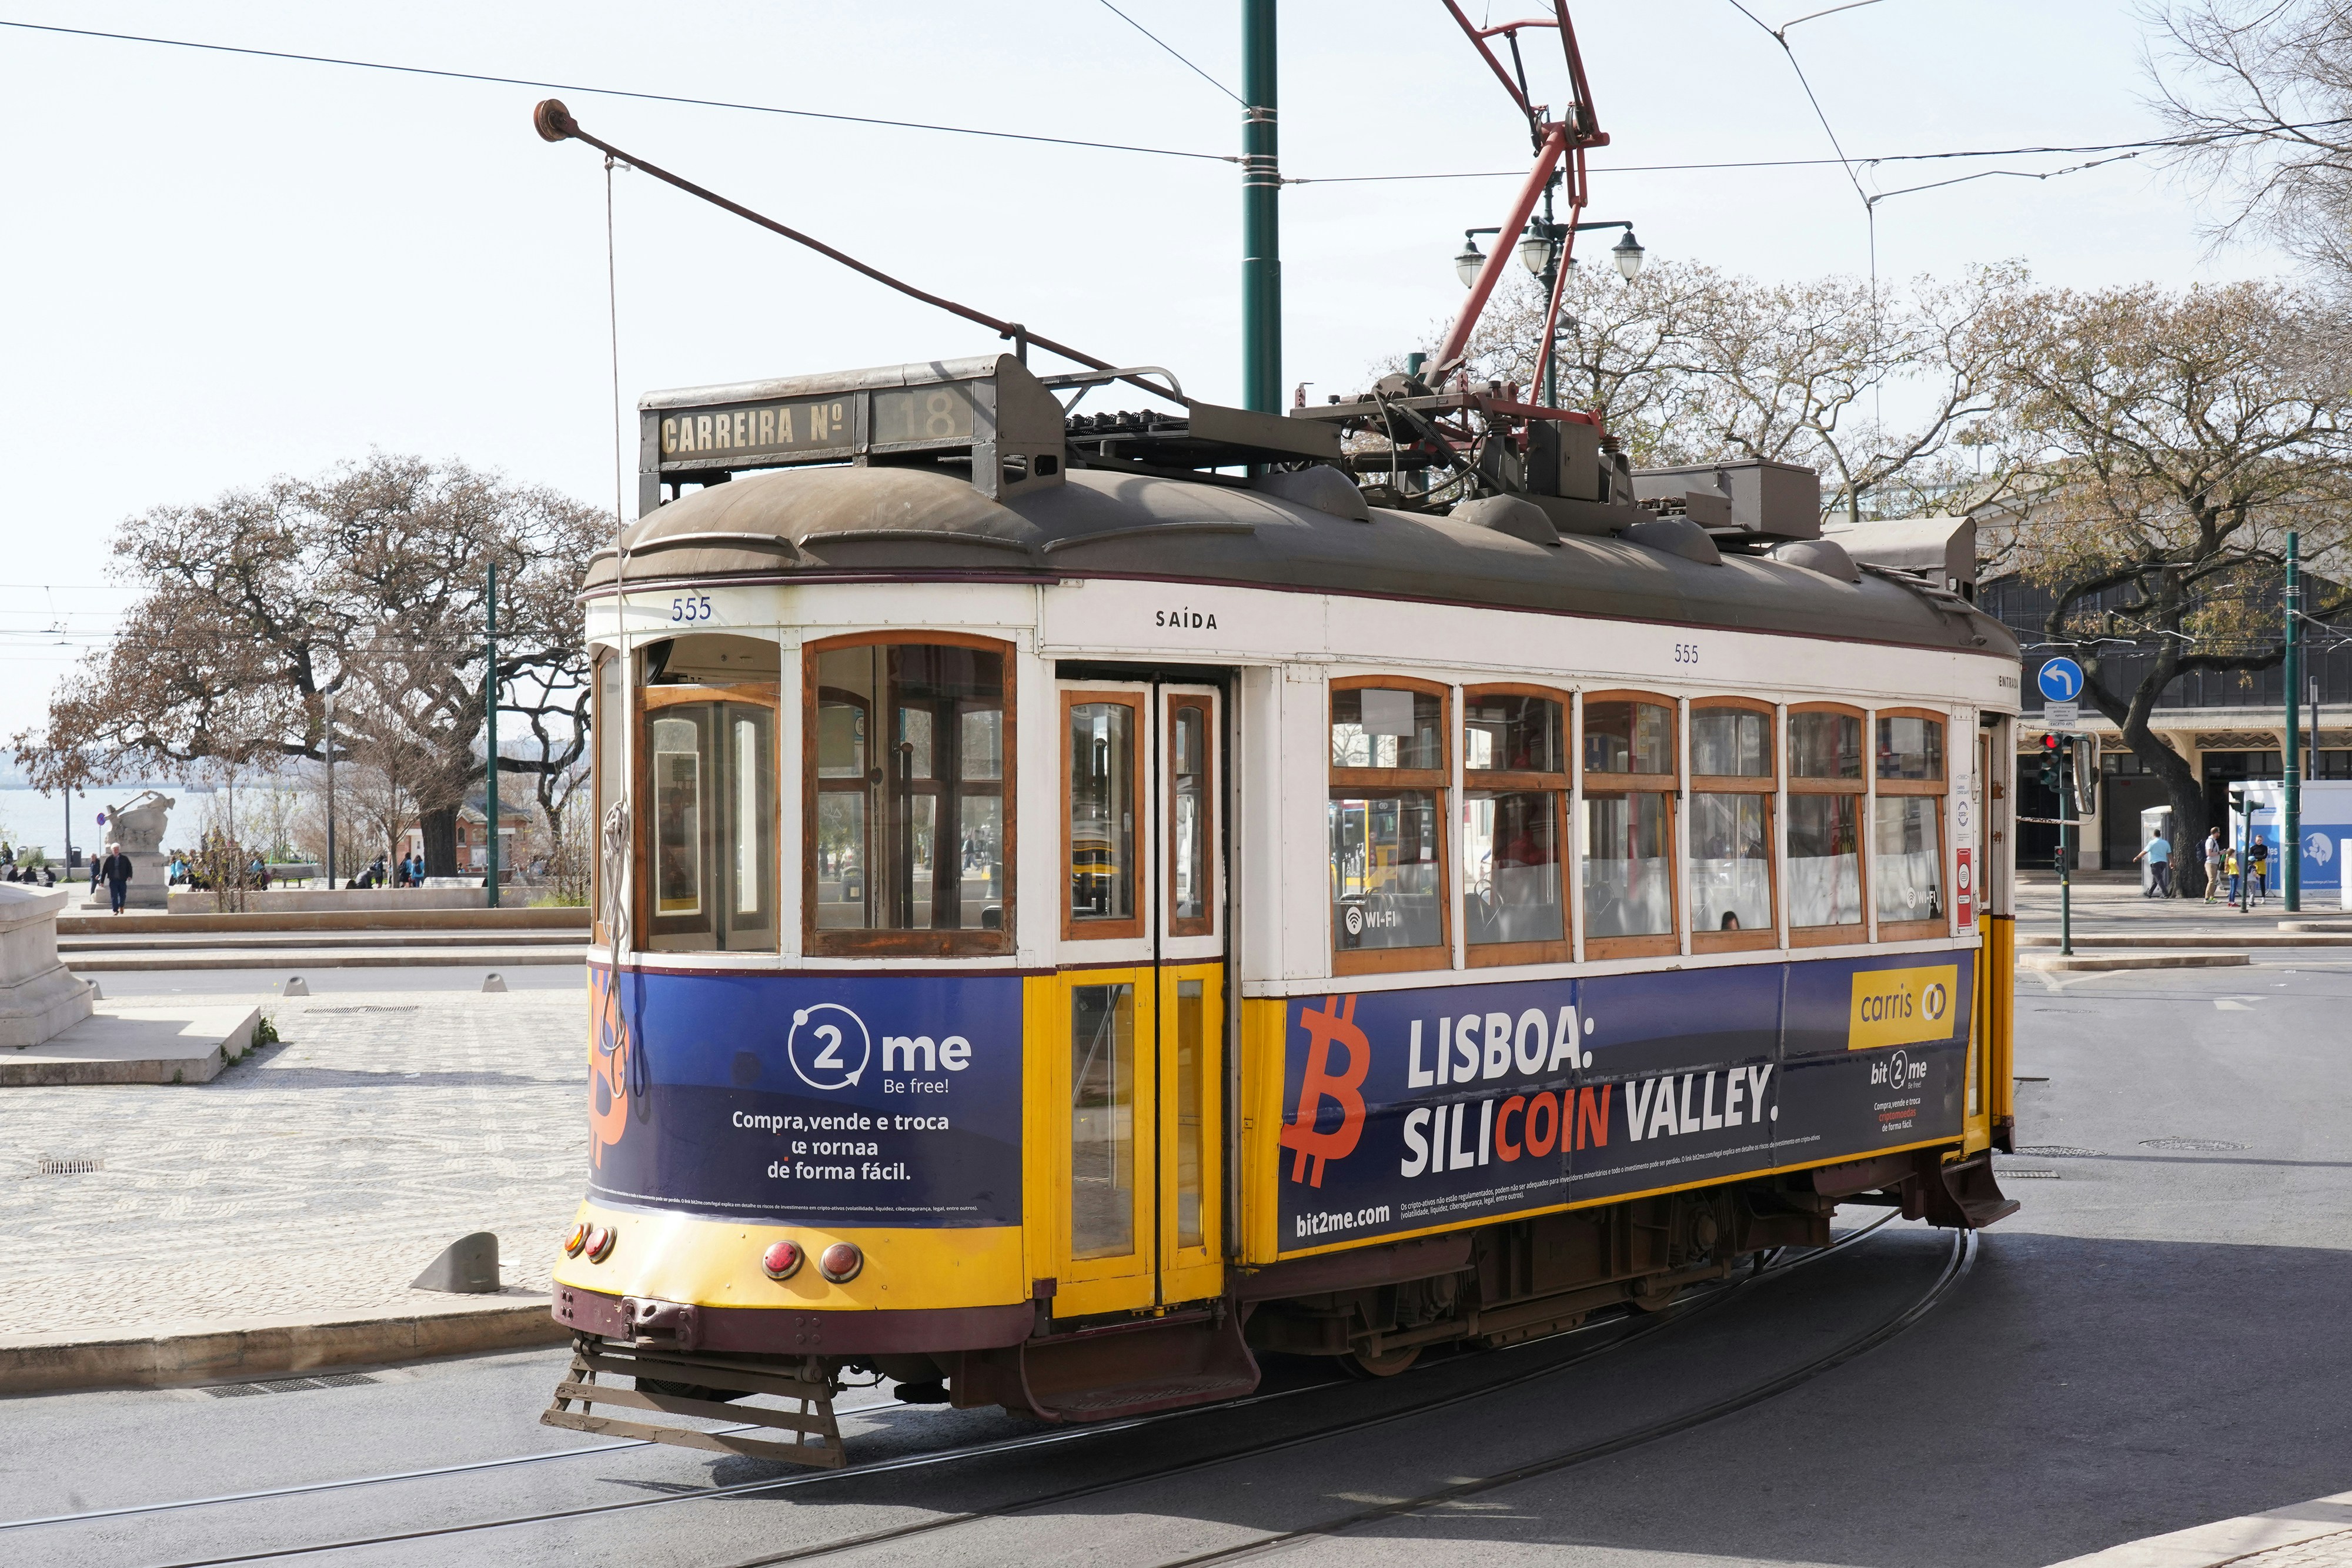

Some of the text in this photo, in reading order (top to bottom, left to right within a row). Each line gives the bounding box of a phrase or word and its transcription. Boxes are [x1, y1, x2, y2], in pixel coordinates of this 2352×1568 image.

[662, 408, 793, 454] CARREIRA
[901, 392, 955, 437] 18
[672, 596, 711, 621] 555
[1156, 607, 1217, 630] SAÍDA
[1675, 644, 1699, 664] 555
[1999, 676, 2019, 689] ENTRADA
[1917, 891, 1936, 904] WI-FI
[1365, 911, 1396, 928] WI-FI
[1862, 983, 1912, 1022] carris
[883, 1035, 972, 1072] me
[1408, 1006, 1594, 1089] LISBOA:
[1871, 1061, 1887, 1085] bit
[1908, 1061, 1927, 1079] me
[884, 1078, 949, 1094] Be free!
[877, 1115, 888, 1131] e
[894, 1112, 949, 1131] troca
[1401, 1064, 1779, 1178] SILICOIN VALLEY.
[1879, 1108, 1916, 1123] criptomoedas
[1882, 1119, 1912, 1132] de forma fácil.
[767, 1161, 911, 1181] de forma fácil.
[1408, 1199, 1436, 1211] cripto-ativos
[1445, 1195, 1458, 1203] estão
[1458, 1188, 1494, 1201] regulamentados,
[1495, 1185, 1509, 1196] podem
[1510, 1183, 1518, 1191] não
[1526, 1179, 1549, 1189] adequados
[1549, 1177, 1559, 1186] para
[1584, 1169, 1608, 1179] minoritários
[1624, 1163, 1649, 1172] investimento
[1649, 1161, 1659, 1169] pode
[1666, 1158, 1681, 1166] perdido.
[1692, 1149, 1722, 1161] bit2me.com/legal
[1723, 1148, 1735, 1156] explica
[1800, 1135, 1820, 1144] cripto-ativos
[1401, 1191, 1524, 1220] (volatilidade, liquidez, cibersegurança, legal, entre outros).
[1297, 1203, 1390, 1238] bit2me.com
